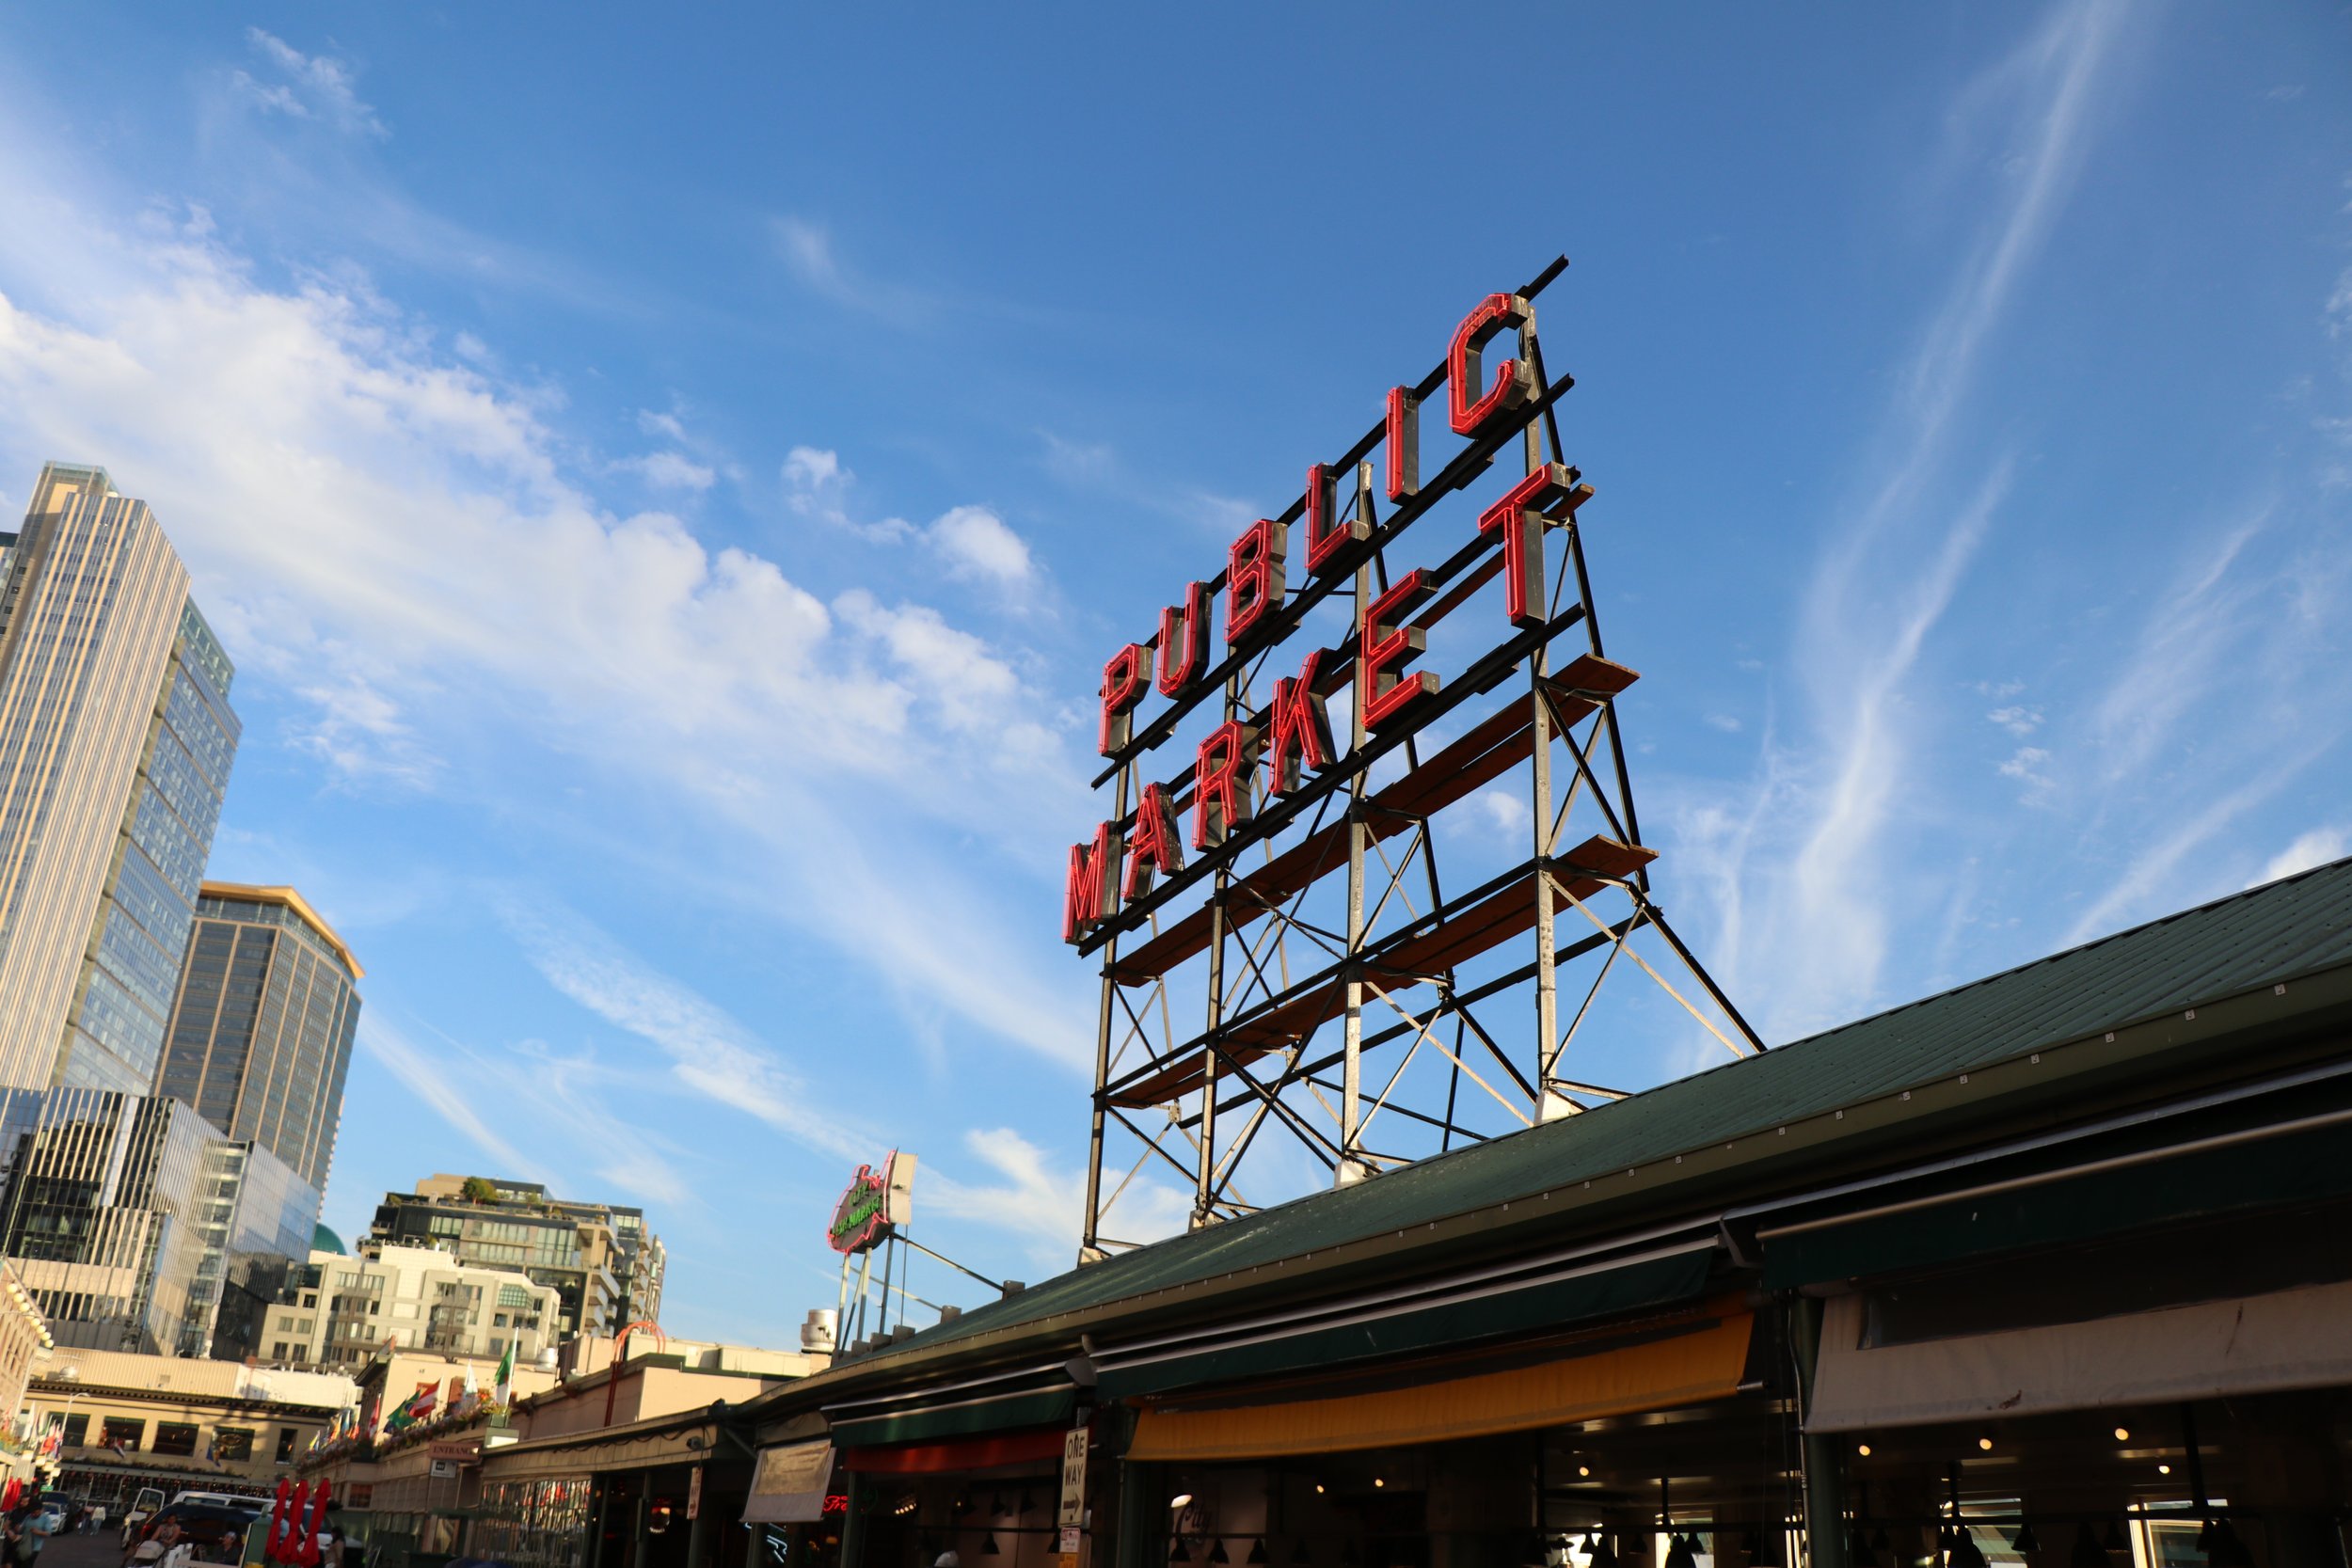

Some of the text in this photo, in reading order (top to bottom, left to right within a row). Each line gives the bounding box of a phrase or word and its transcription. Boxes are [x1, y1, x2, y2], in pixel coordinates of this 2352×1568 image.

[1100, 293, 1528, 756] PUBLIC
[1064, 462, 1571, 942] MARKET
[1065, 1464, 1084, 1486] WAY
[1066, 1435, 1086, 1460] ONE
